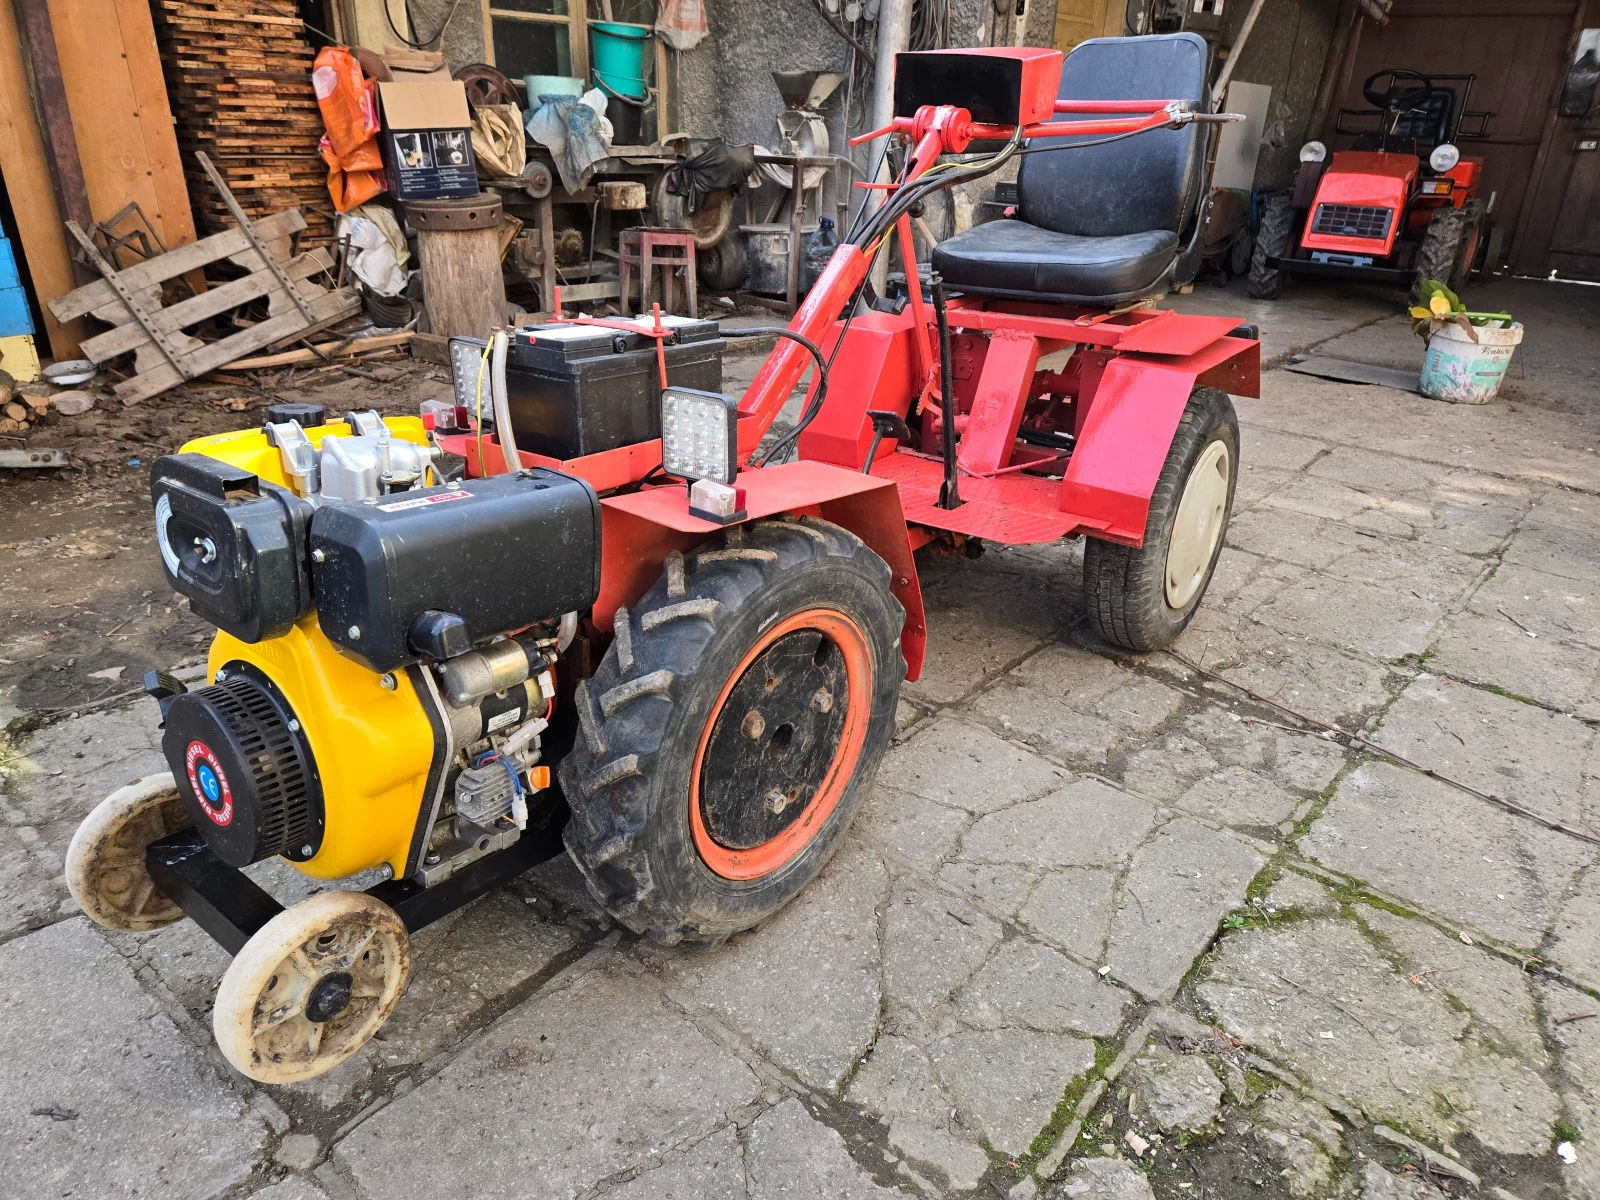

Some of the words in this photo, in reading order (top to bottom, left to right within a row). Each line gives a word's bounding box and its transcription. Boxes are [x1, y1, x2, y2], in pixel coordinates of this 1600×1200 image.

[187, 744, 204, 771] DIESEL
[207, 753, 229, 795] DIESEL
[190, 775, 212, 815] DIESEL
[213, 802, 231, 822] DIESEL
